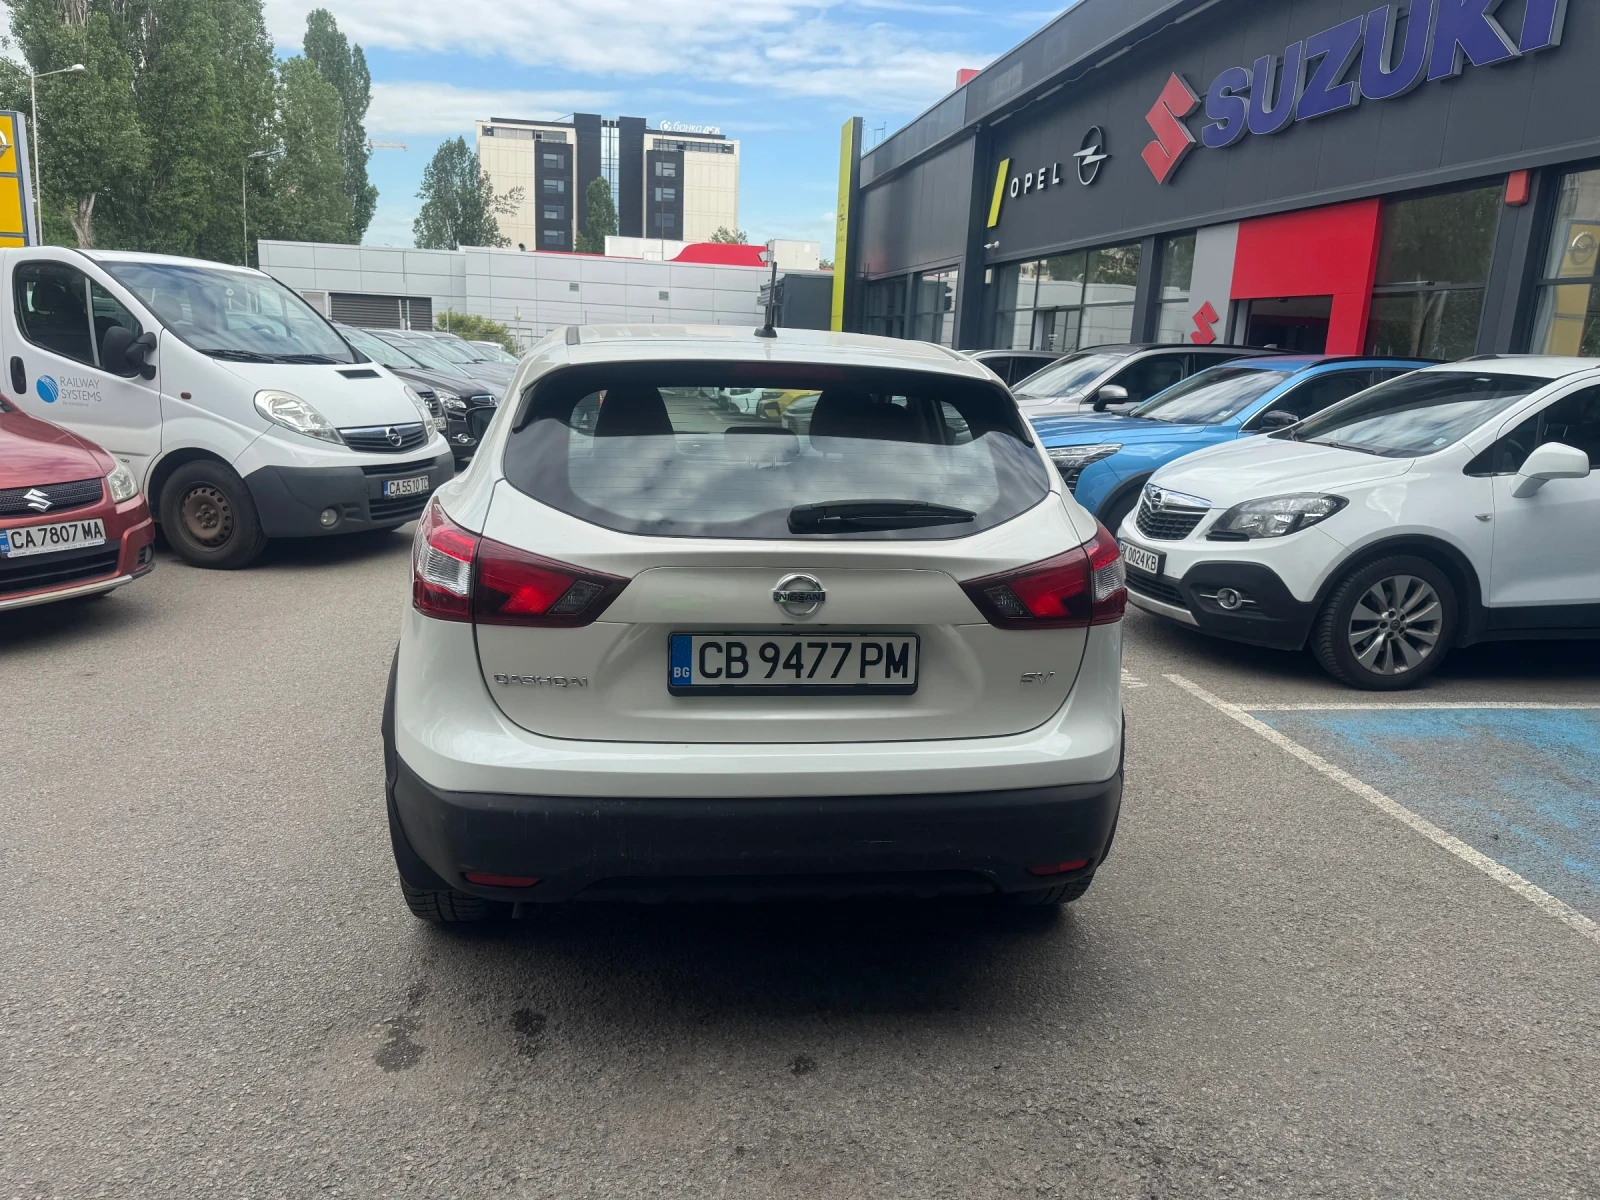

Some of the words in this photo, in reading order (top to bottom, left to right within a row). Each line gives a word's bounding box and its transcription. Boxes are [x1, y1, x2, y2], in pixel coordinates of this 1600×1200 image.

[1010, 163, 1060, 198] OPEL
[60, 375, 100, 389] RAILWAY
[61, 388, 102, 402] SYSTEMS
[389, 482, 401, 494] CA
[10, 529, 36, 549] CA
[38, 523, 78, 546] 7807
[81, 521, 103, 540] MA
[778, 592, 821, 602] NISSAN
[699, 641, 749, 679] CB
[758, 641, 852, 679] 9477
[859, 642, 909, 679] PM
[674, 667, 690, 678] BG
[1021, 671, 1056, 684] SV
[493, 673, 588, 688] QASHQAI
